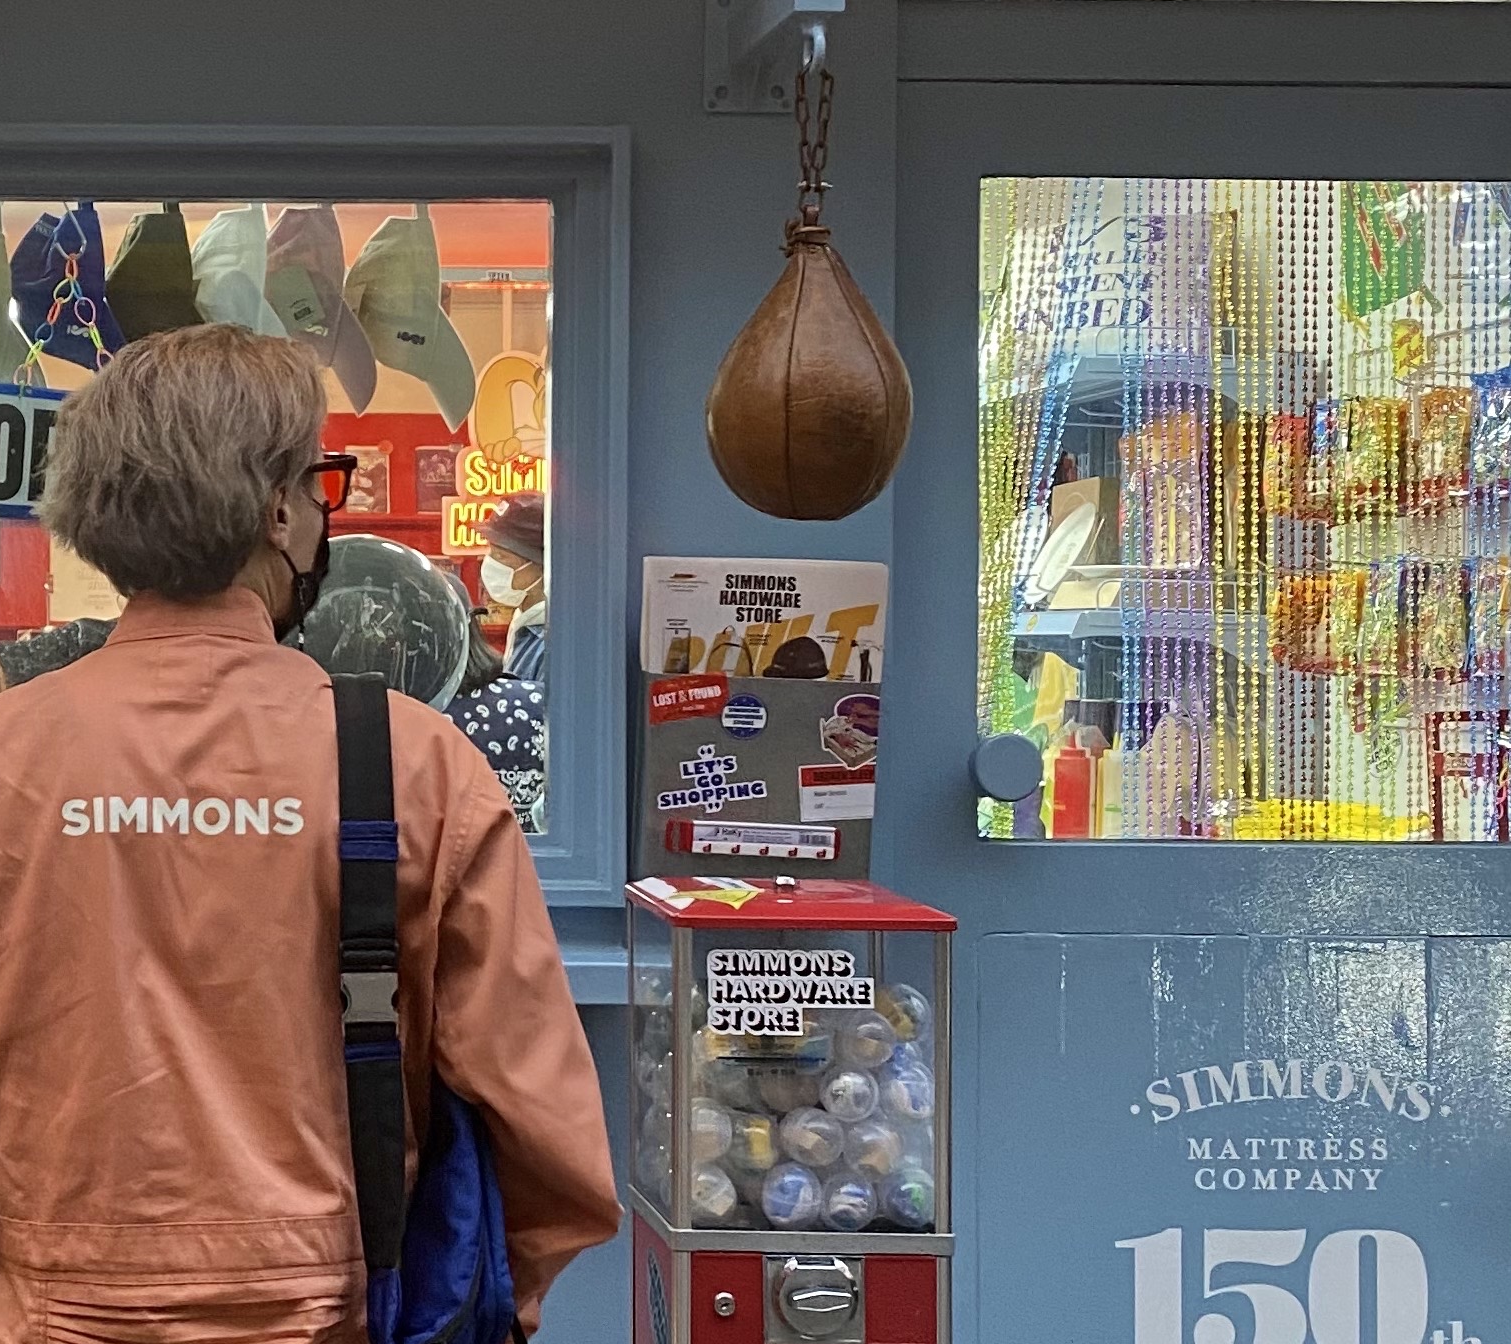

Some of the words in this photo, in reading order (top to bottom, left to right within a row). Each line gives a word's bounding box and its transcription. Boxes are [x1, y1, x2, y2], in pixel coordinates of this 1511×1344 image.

[1062, 297, 1152, 330] BED
[725, 574, 797, 592] SIMMONS
[719, 590, 801, 609] HARDWARE
[735, 607, 782, 624] STORE
[653, 692, 677, 708] LOST
[688, 685, 722, 701] FOUND
[697, 774, 724, 788] GO
[660, 783, 764, 808] SHOPPING
[61, 796, 304, 837] SIMMONS
[709, 951, 853, 977] SIMMONS
[711, 978, 871, 1005] HARDWARE
[710, 1007, 800, 1032] STORE
[1146, 1058, 1436, 1123] SIMMONS
[1188, 1138, 1389, 1161] MATTRESS
[1194, 1168, 1383, 1191] COMPANY
